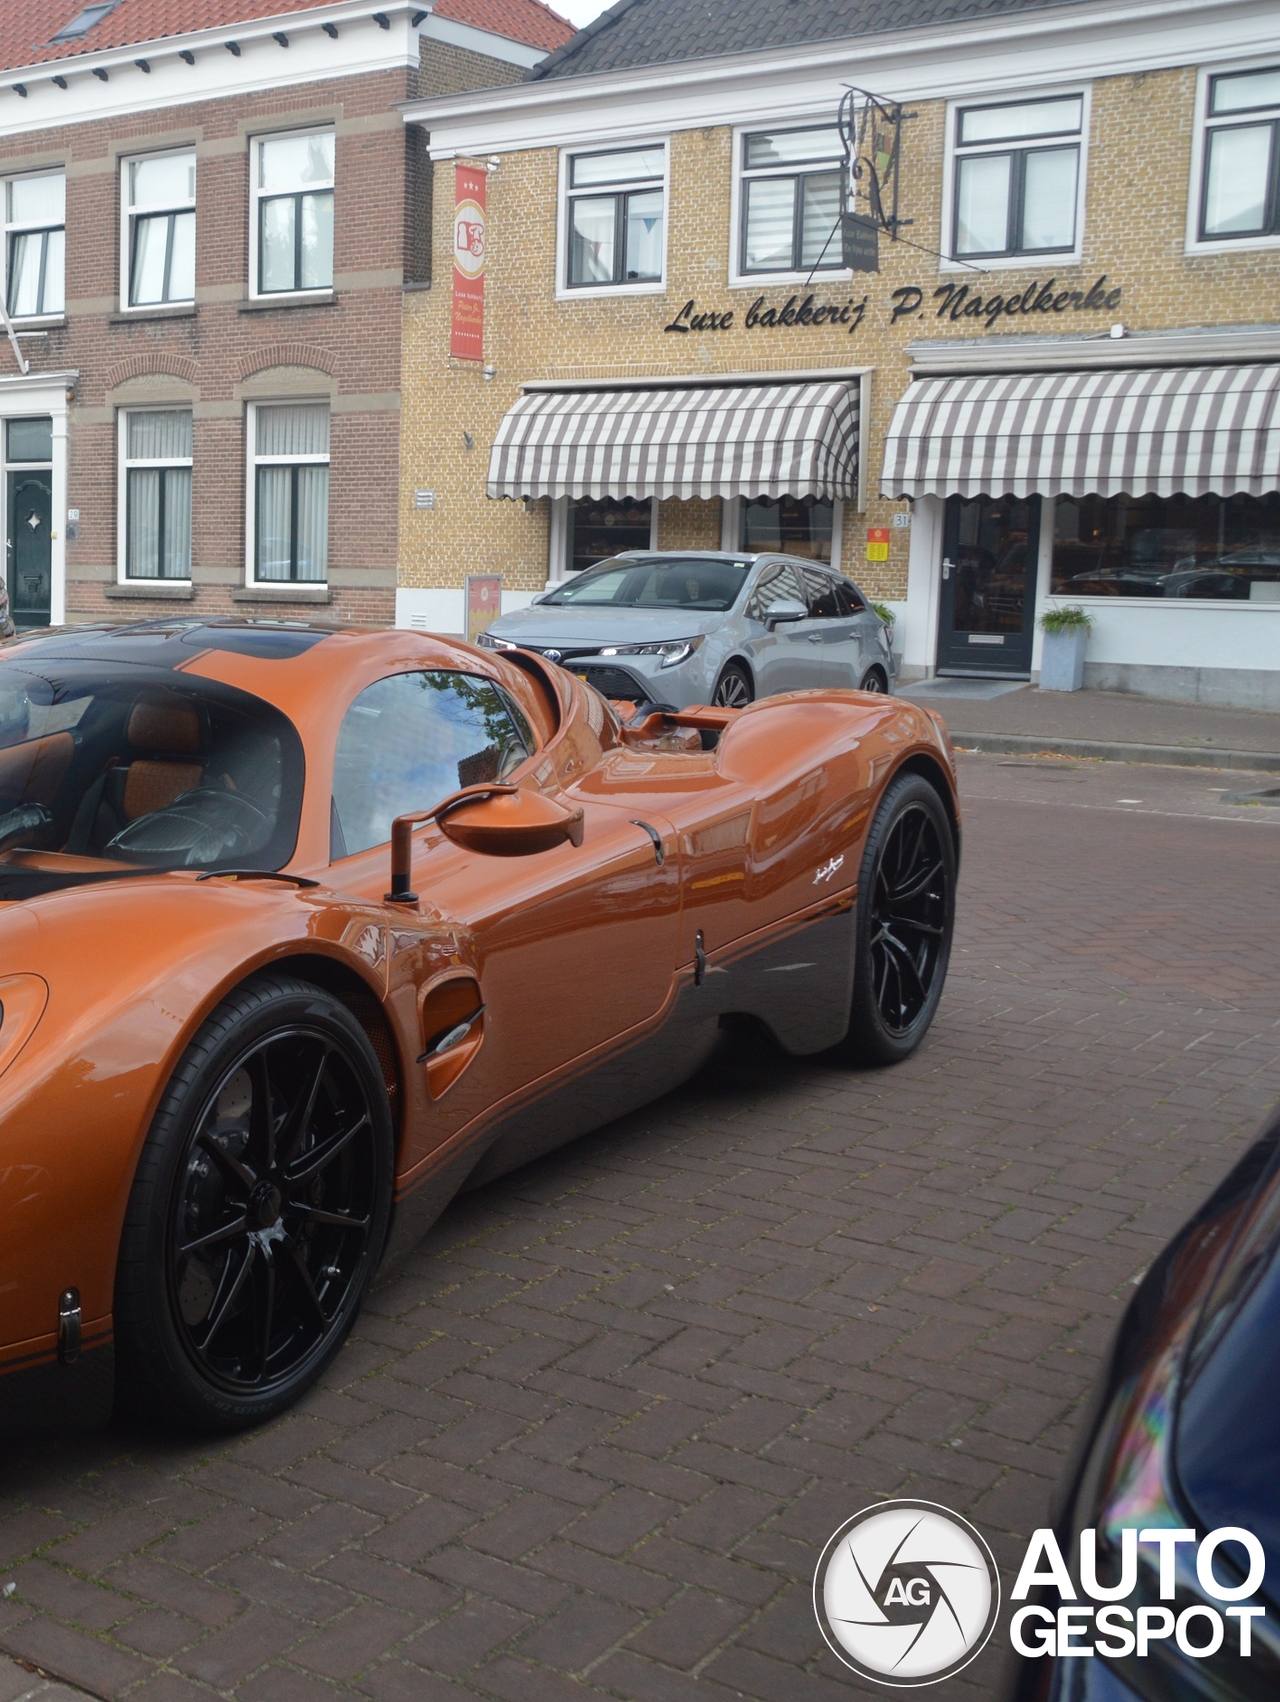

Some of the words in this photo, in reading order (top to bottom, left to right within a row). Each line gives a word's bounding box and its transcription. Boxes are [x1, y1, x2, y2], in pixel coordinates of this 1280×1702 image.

[664, 299, 733, 333] Luxe
[745, 293, 869, 334] bakkerij
[933, 275, 1122, 328] Nagelkerke
[896, 515, 907, 526] 31
